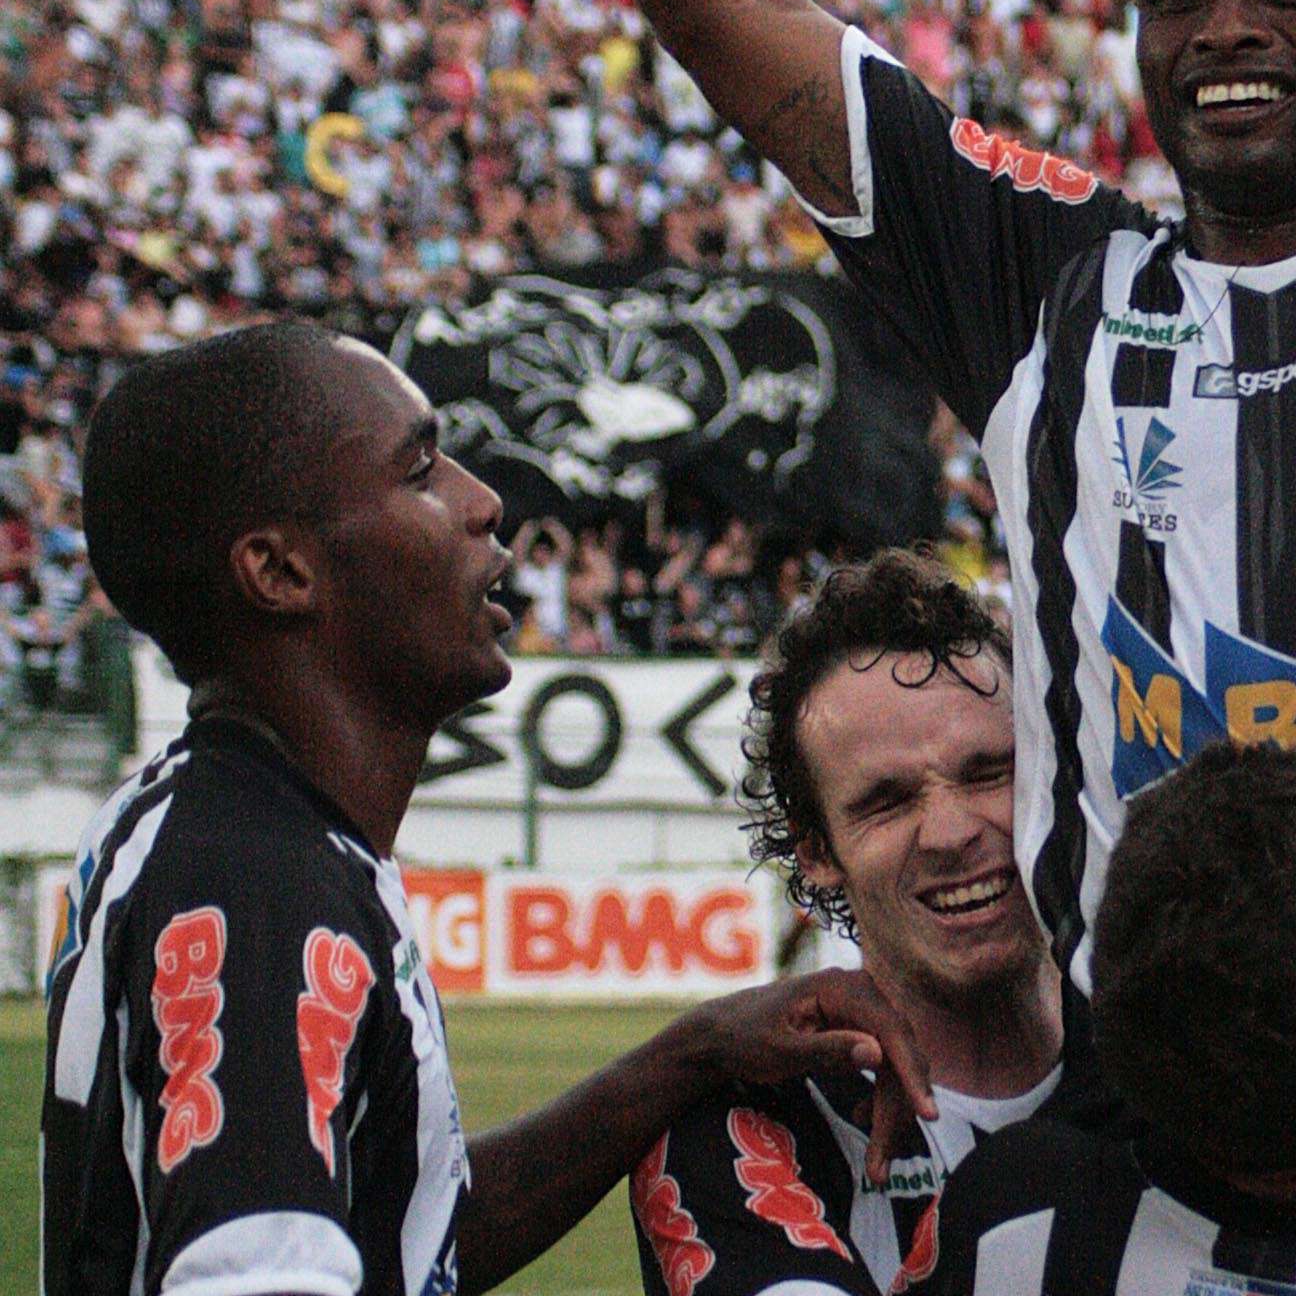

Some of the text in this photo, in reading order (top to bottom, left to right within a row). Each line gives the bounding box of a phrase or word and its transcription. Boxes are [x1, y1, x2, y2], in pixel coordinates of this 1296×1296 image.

[1101, 311, 1175, 345] nimed
[506, 884, 758, 976] BMG
[151, 906, 227, 1174] BMG
